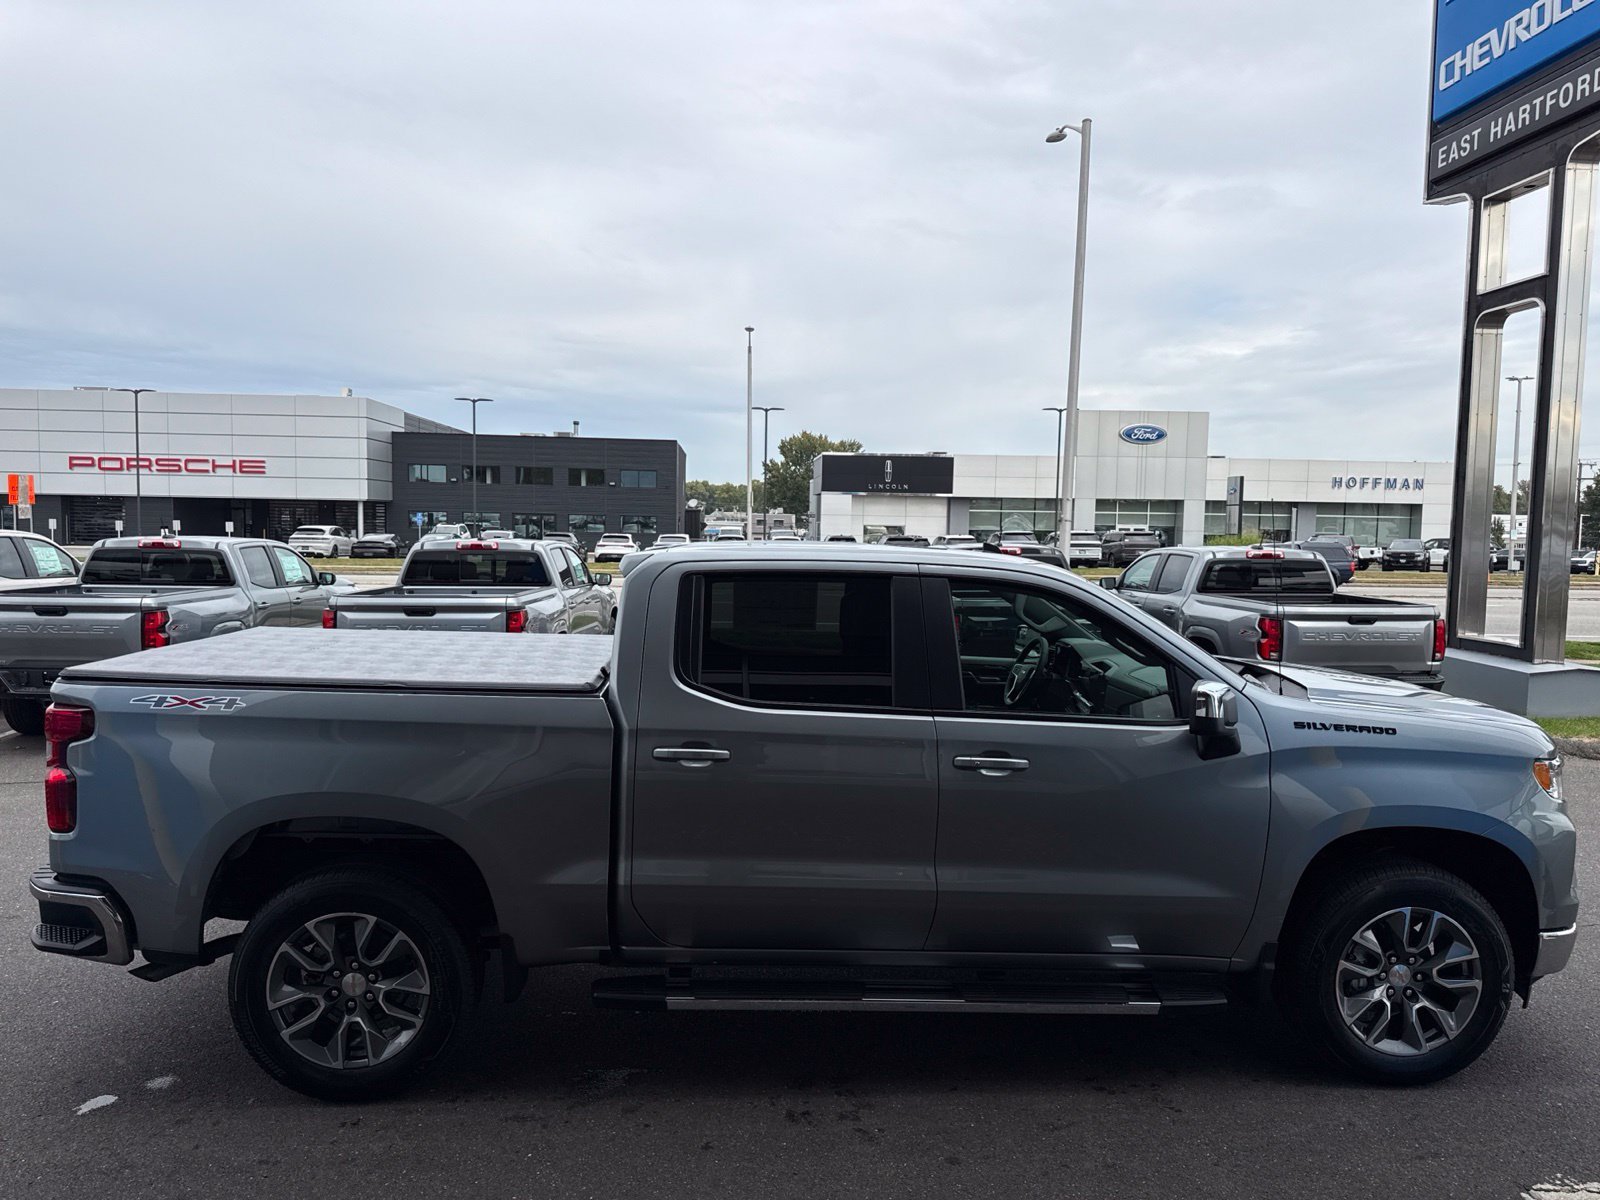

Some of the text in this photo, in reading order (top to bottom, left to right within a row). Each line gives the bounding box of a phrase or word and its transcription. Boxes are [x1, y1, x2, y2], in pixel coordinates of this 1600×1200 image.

[1437, 128, 1482, 168] EAST
[68, 455, 266, 475] PORSCHE
[1331, 476, 1424, 490] HOFFMAN
[1301, 631, 1421, 641] CHEVROLET
[1293, 721, 1398, 736] SILVERADO
